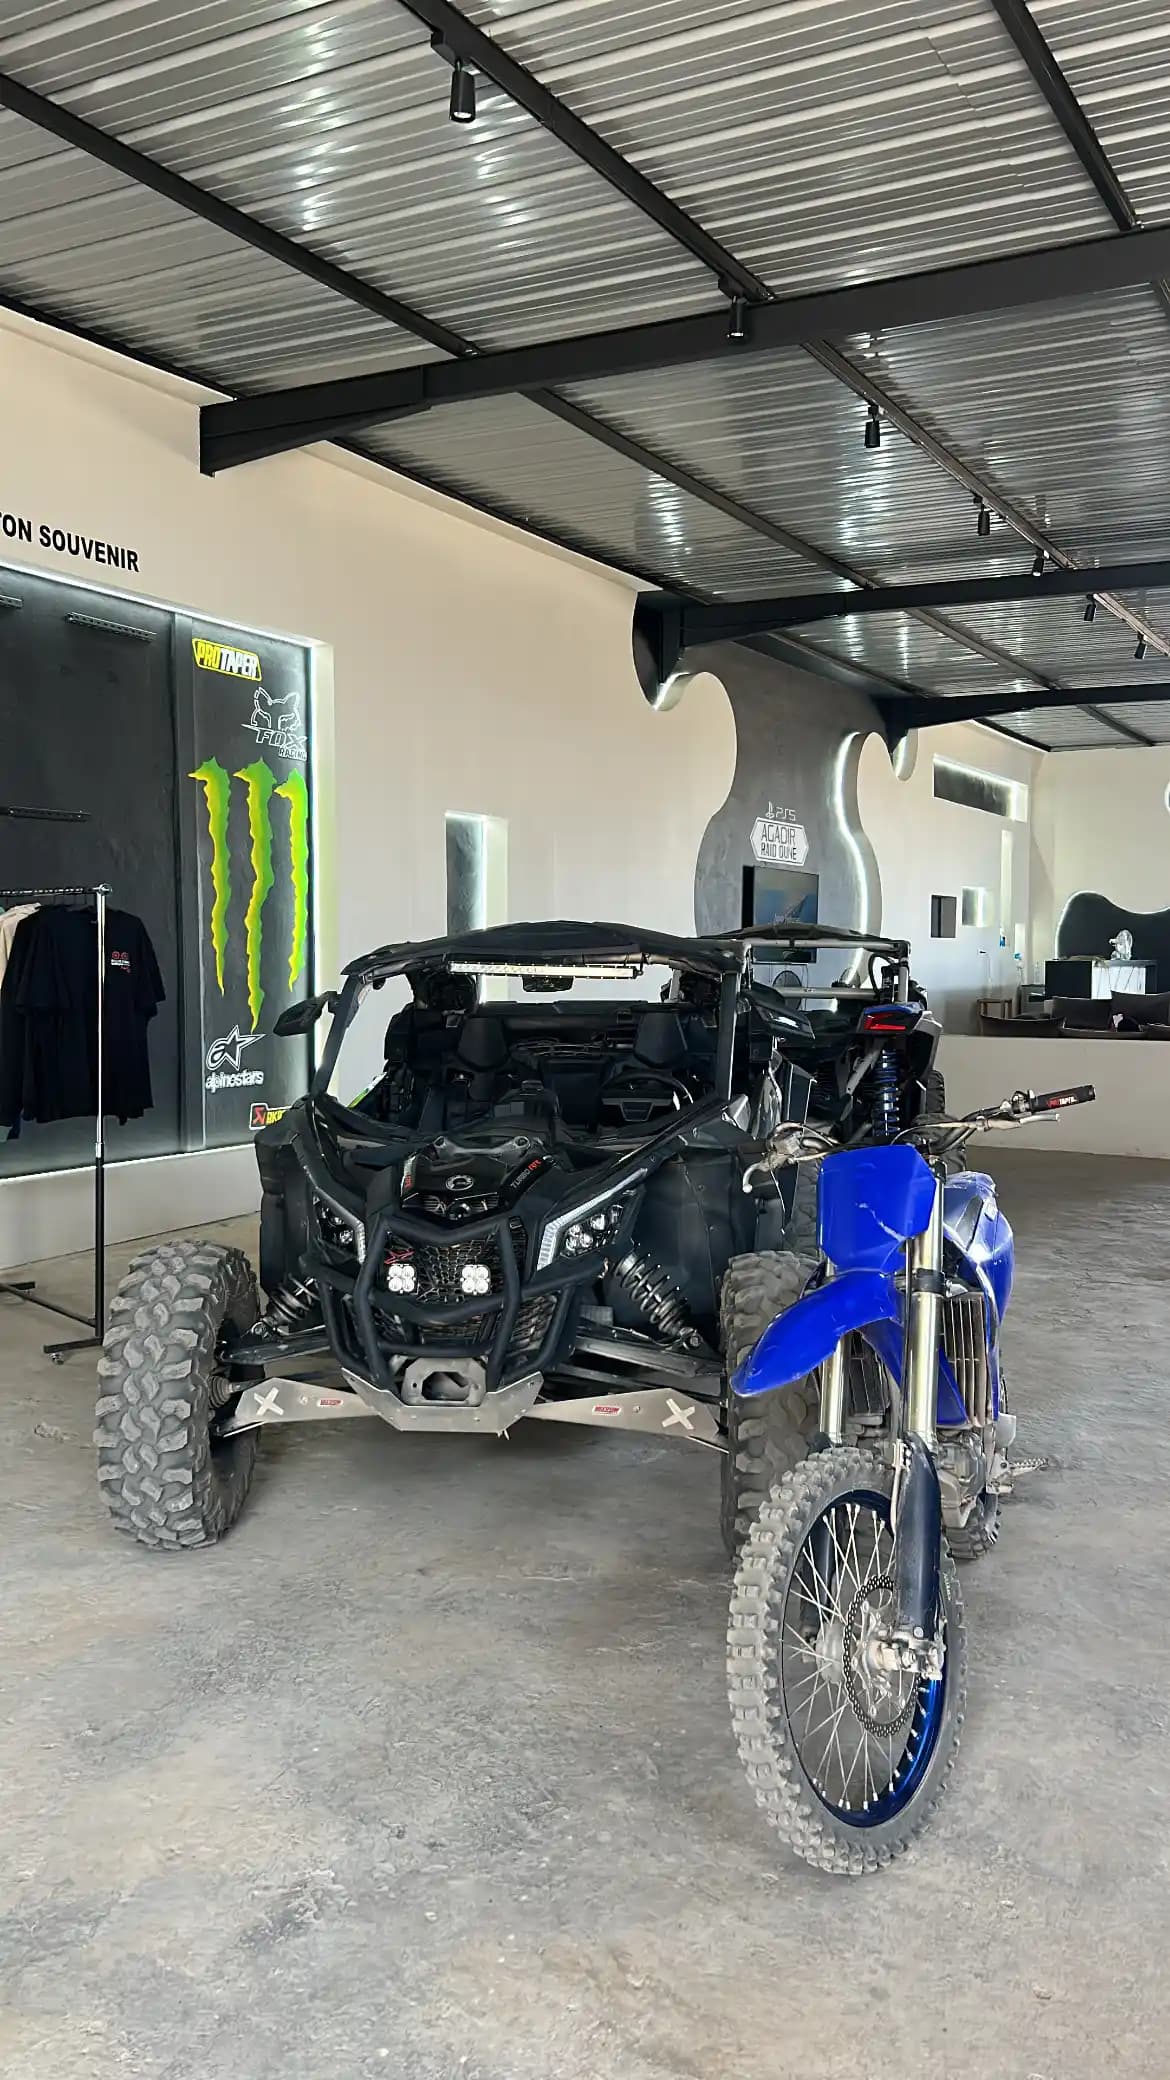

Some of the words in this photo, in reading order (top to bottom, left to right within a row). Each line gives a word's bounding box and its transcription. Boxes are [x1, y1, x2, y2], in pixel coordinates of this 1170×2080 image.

[0, 511, 32, 542] ON
[39, 525, 140, 573] SOUVENIR
[196, 641, 258, 678] PROTAPER
[241, 723, 307, 751] FOX
[775, 806, 796, 821] PS5
[761, 823, 796, 846] AGADIR
[205, 1068, 264, 1093] alpinestars
[510, 1168, 531, 1189] TURBO
